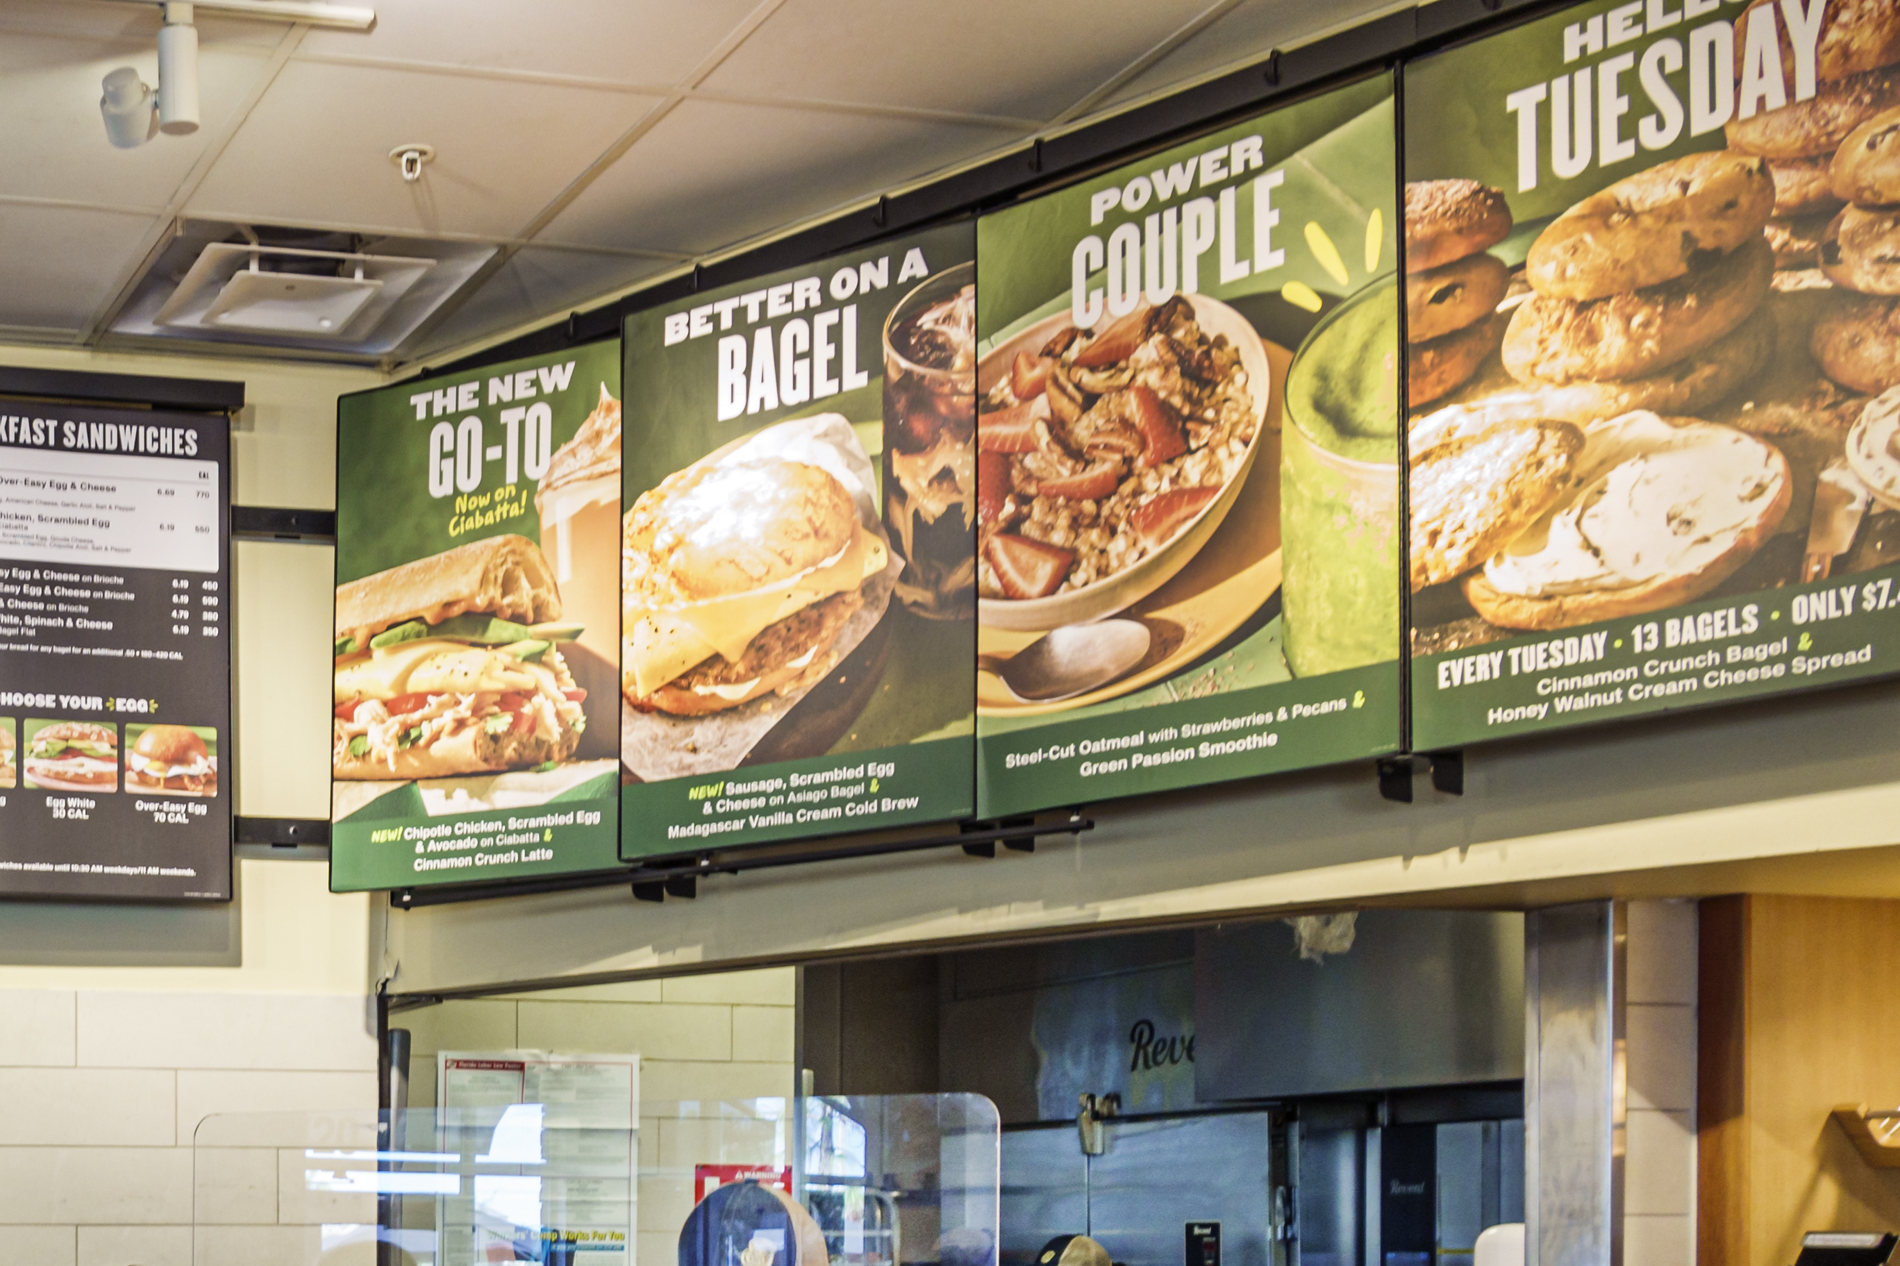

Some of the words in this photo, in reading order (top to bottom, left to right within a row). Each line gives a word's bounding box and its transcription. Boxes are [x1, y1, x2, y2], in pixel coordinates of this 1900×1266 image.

[1564, 0, 1746, 64] HELL
[1507, 0, 1826, 194] TUESDAY
[1090, 134, 1264, 227] POWER
[1071, 170, 1286, 331] COUPLE
[664, 277, 822, 346] BETTER
[829, 255, 890, 298] ON
[898, 247, 929, 285] A
[717, 304, 868, 422] BAGEL
[410, 389, 480, 421] THE
[488, 361, 576, 402] NEW
[63, 420, 198, 456] SANDWICHES
[428, 402, 552, 499] GO-TO
[449, 490, 527, 538] Ciabatta!
[455, 491, 491, 514] Now
[495, 485, 516, 502] on
[1438, 650, 1503, 690] EVERY
[1508, 631, 1608, 676] TUESDAY
[1631, 621, 1659, 654] 13
[1665, 603, 1758, 649] BAGELS
[1792, 583, 1859, 625] ONLY
[1862, 578, 1900, 613] $7.
[59, 695, 103, 711] YOUR
[115, 698, 149, 713] EGG
[1488, 700, 1549, 726] Honey
[1553, 689, 1623, 714] Walnut
[1627, 676, 1698, 703] Cream
[1703, 661, 1786, 689] Cheese
[1791, 644, 1872, 677] Spread
[1080, 758, 1128, 777] Green
[1132, 747, 1195, 769] Passion
[1199, 731, 1278, 758] Smoothie
[46, 796, 65, 809] Egg
[67, 796, 95, 809] White
[689, 783, 724, 801] NEW!
[725, 774, 787, 796] Sausage,
[789, 766, 864, 788] Scrambled
[867, 761, 896, 778] Egg
[371, 827, 403, 844] NEW!
[404, 822, 451, 842] Chipotle
[455, 818, 505, 836] Chicken,
[508, 811, 573, 832] Scrambled
[576, 810, 600, 826] Egg
[668, 818, 747, 839] Madagascar
[750, 811, 793, 829] Vanilla
[796, 806, 842, 823] Cream
[845, 800, 877, 817] Cold
[881, 795, 919, 813] Brew
[413, 854, 471, 872] Cinnamon
[474, 851, 517, 868] Crunch
[520, 847, 553, 862] Latte
[744, 1171, 781, 1179] WARNING
[559, 1231, 589, 1240] Works
[592, 1231, 607, 1240] For
[609, 1231, 625, 1240] You
